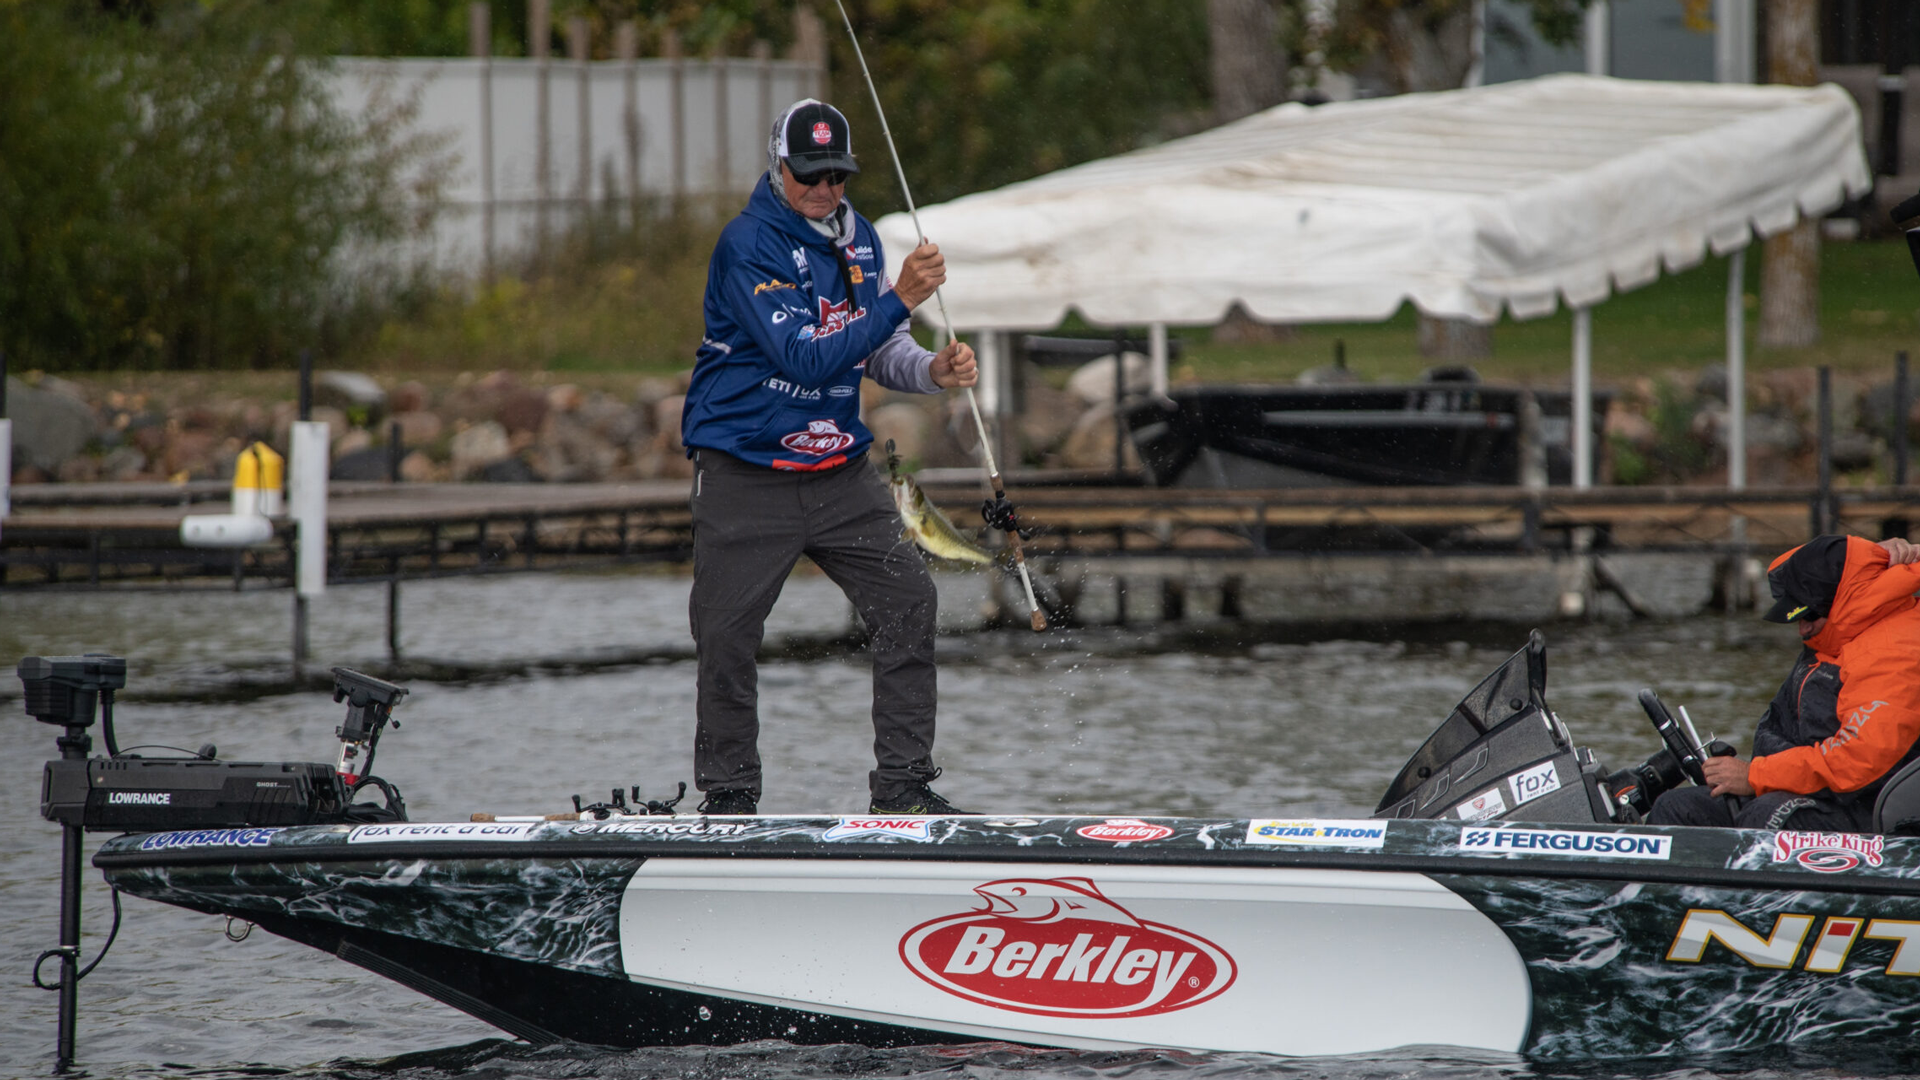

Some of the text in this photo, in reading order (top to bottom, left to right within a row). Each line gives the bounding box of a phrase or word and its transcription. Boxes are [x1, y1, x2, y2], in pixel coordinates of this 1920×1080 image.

[1515, 768, 1555, 802] fox
[108, 792, 171, 805] LOWRANCE
[399, 824, 455, 835] rent
[458, 825, 475, 835] a
[480, 825, 526, 835] car
[597, 823, 759, 836] MERCURY
[843, 820, 926, 829] SONIC
[142, 828, 284, 850] LOWRANCE
[1088, 826, 1160, 839] Berkley
[1258, 826, 1384, 839] STAR TRON
[1494, 831, 1661, 854] FERGUSON
[1774, 831, 1885, 867] Strike King
[943, 925, 1198, 1006] Berkley
